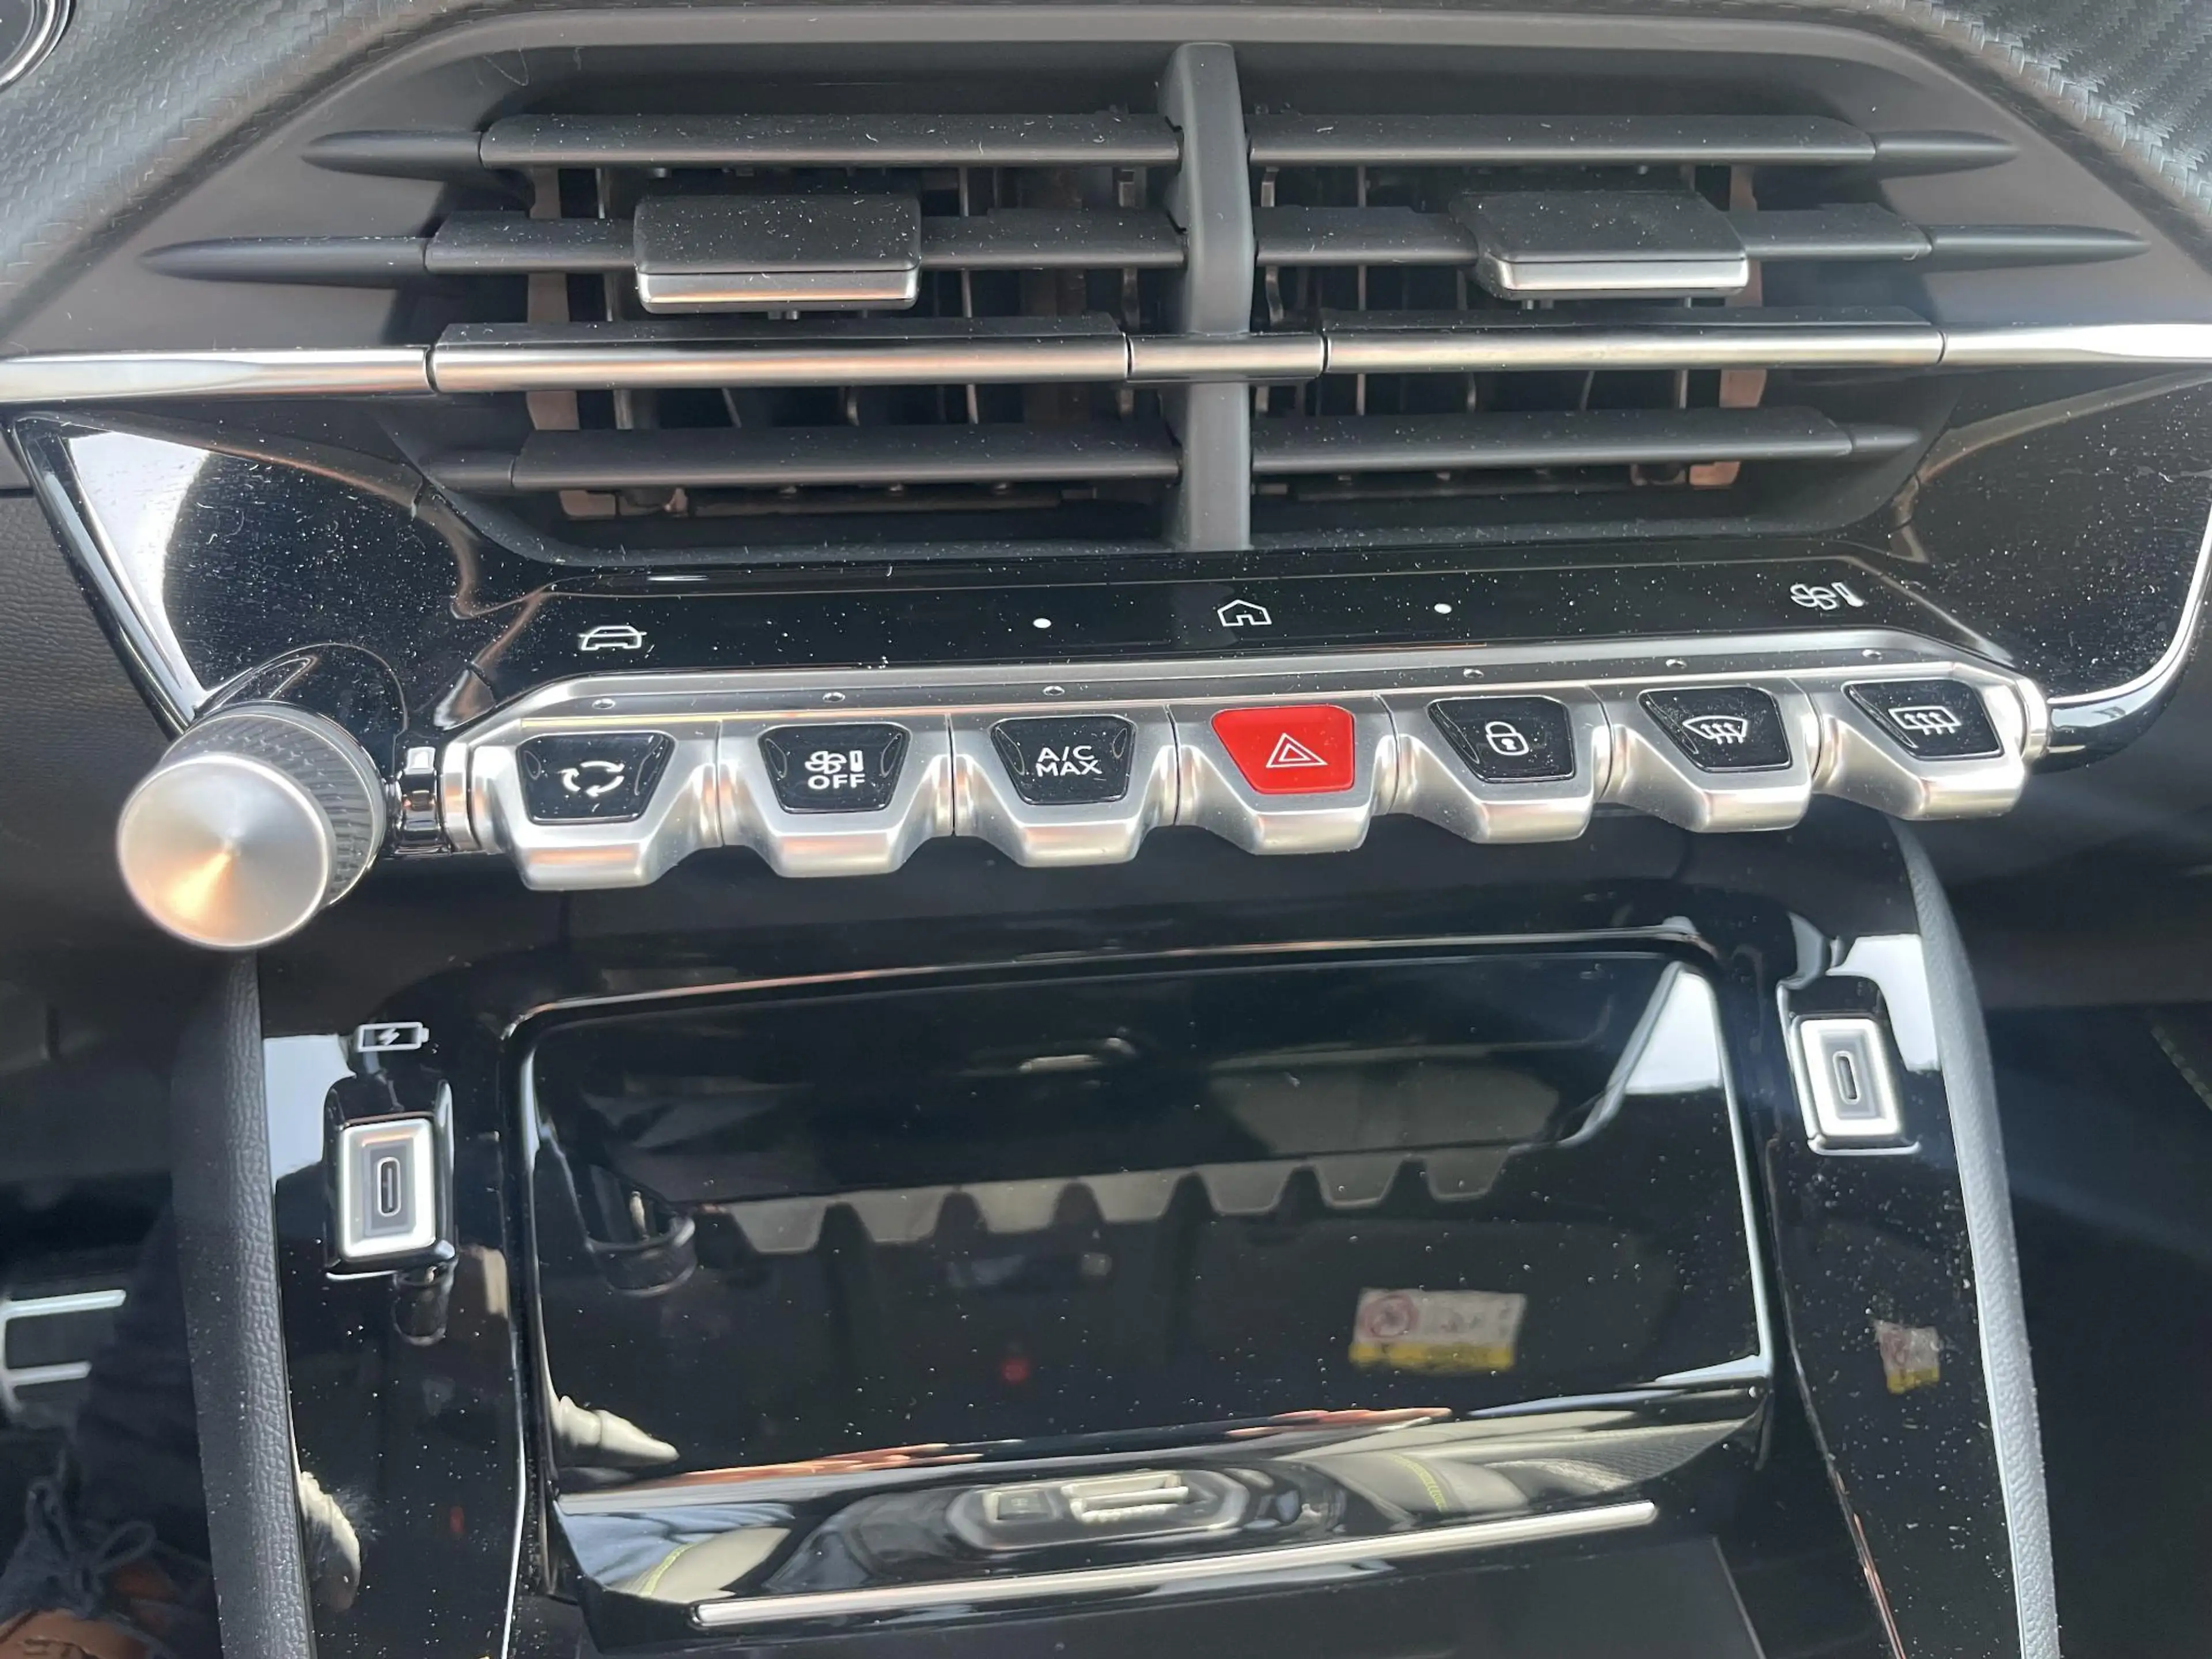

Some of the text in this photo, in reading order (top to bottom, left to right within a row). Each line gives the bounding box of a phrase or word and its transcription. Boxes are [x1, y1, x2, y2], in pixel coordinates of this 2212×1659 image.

[1037, 745, 1094, 762] A/C
[1036, 759, 1103, 777] MAX
[808, 774, 865, 789] OFF
